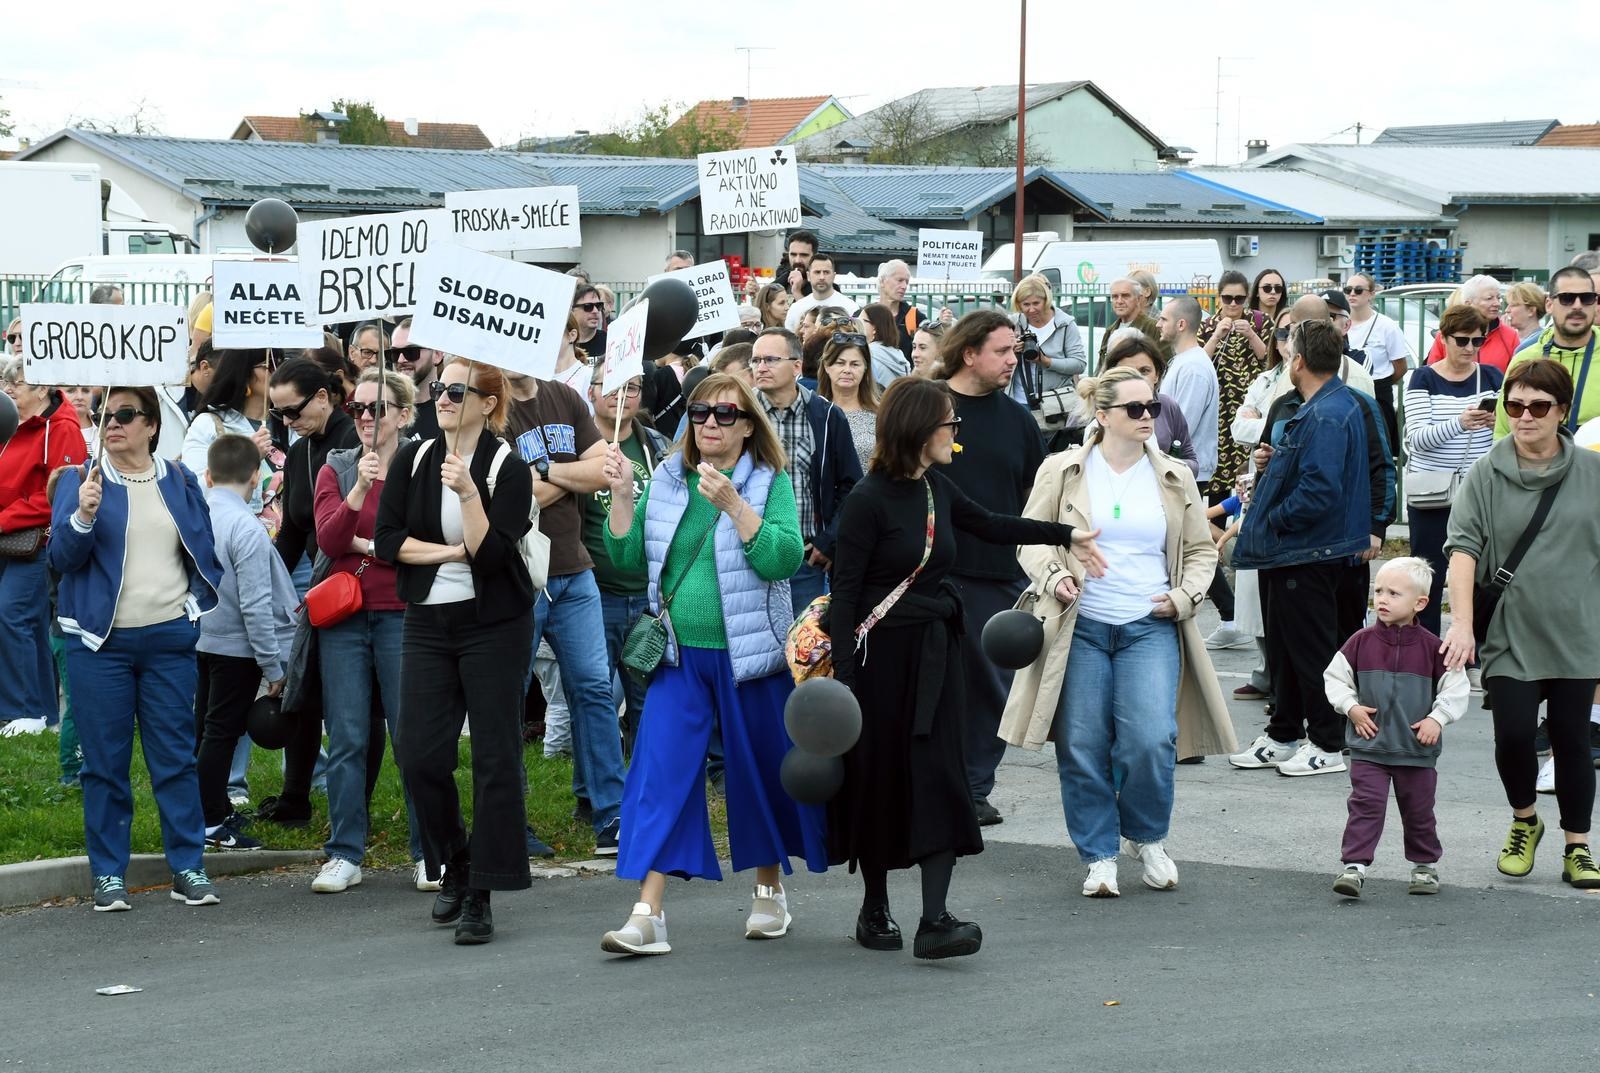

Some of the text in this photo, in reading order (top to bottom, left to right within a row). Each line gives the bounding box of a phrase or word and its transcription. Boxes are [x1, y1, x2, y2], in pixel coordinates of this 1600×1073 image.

[706, 156, 757, 177] ŽIVIMO
[719, 172, 777, 192] AKTIVNO
[735, 191, 766, 208] A NE
[711, 207, 798, 231] RADIOAKTIVNO
[321, 219, 428, 260] IDEMO DO
[697, 271, 725, 286] GRAD
[229, 282, 301, 301] ALAA
[438, 276, 545, 320] SLOBODA
[224, 308, 305, 325] NEĆETE
[432, 300, 541, 344] DISANJU!
[543, 423, 577, 454] STATE
